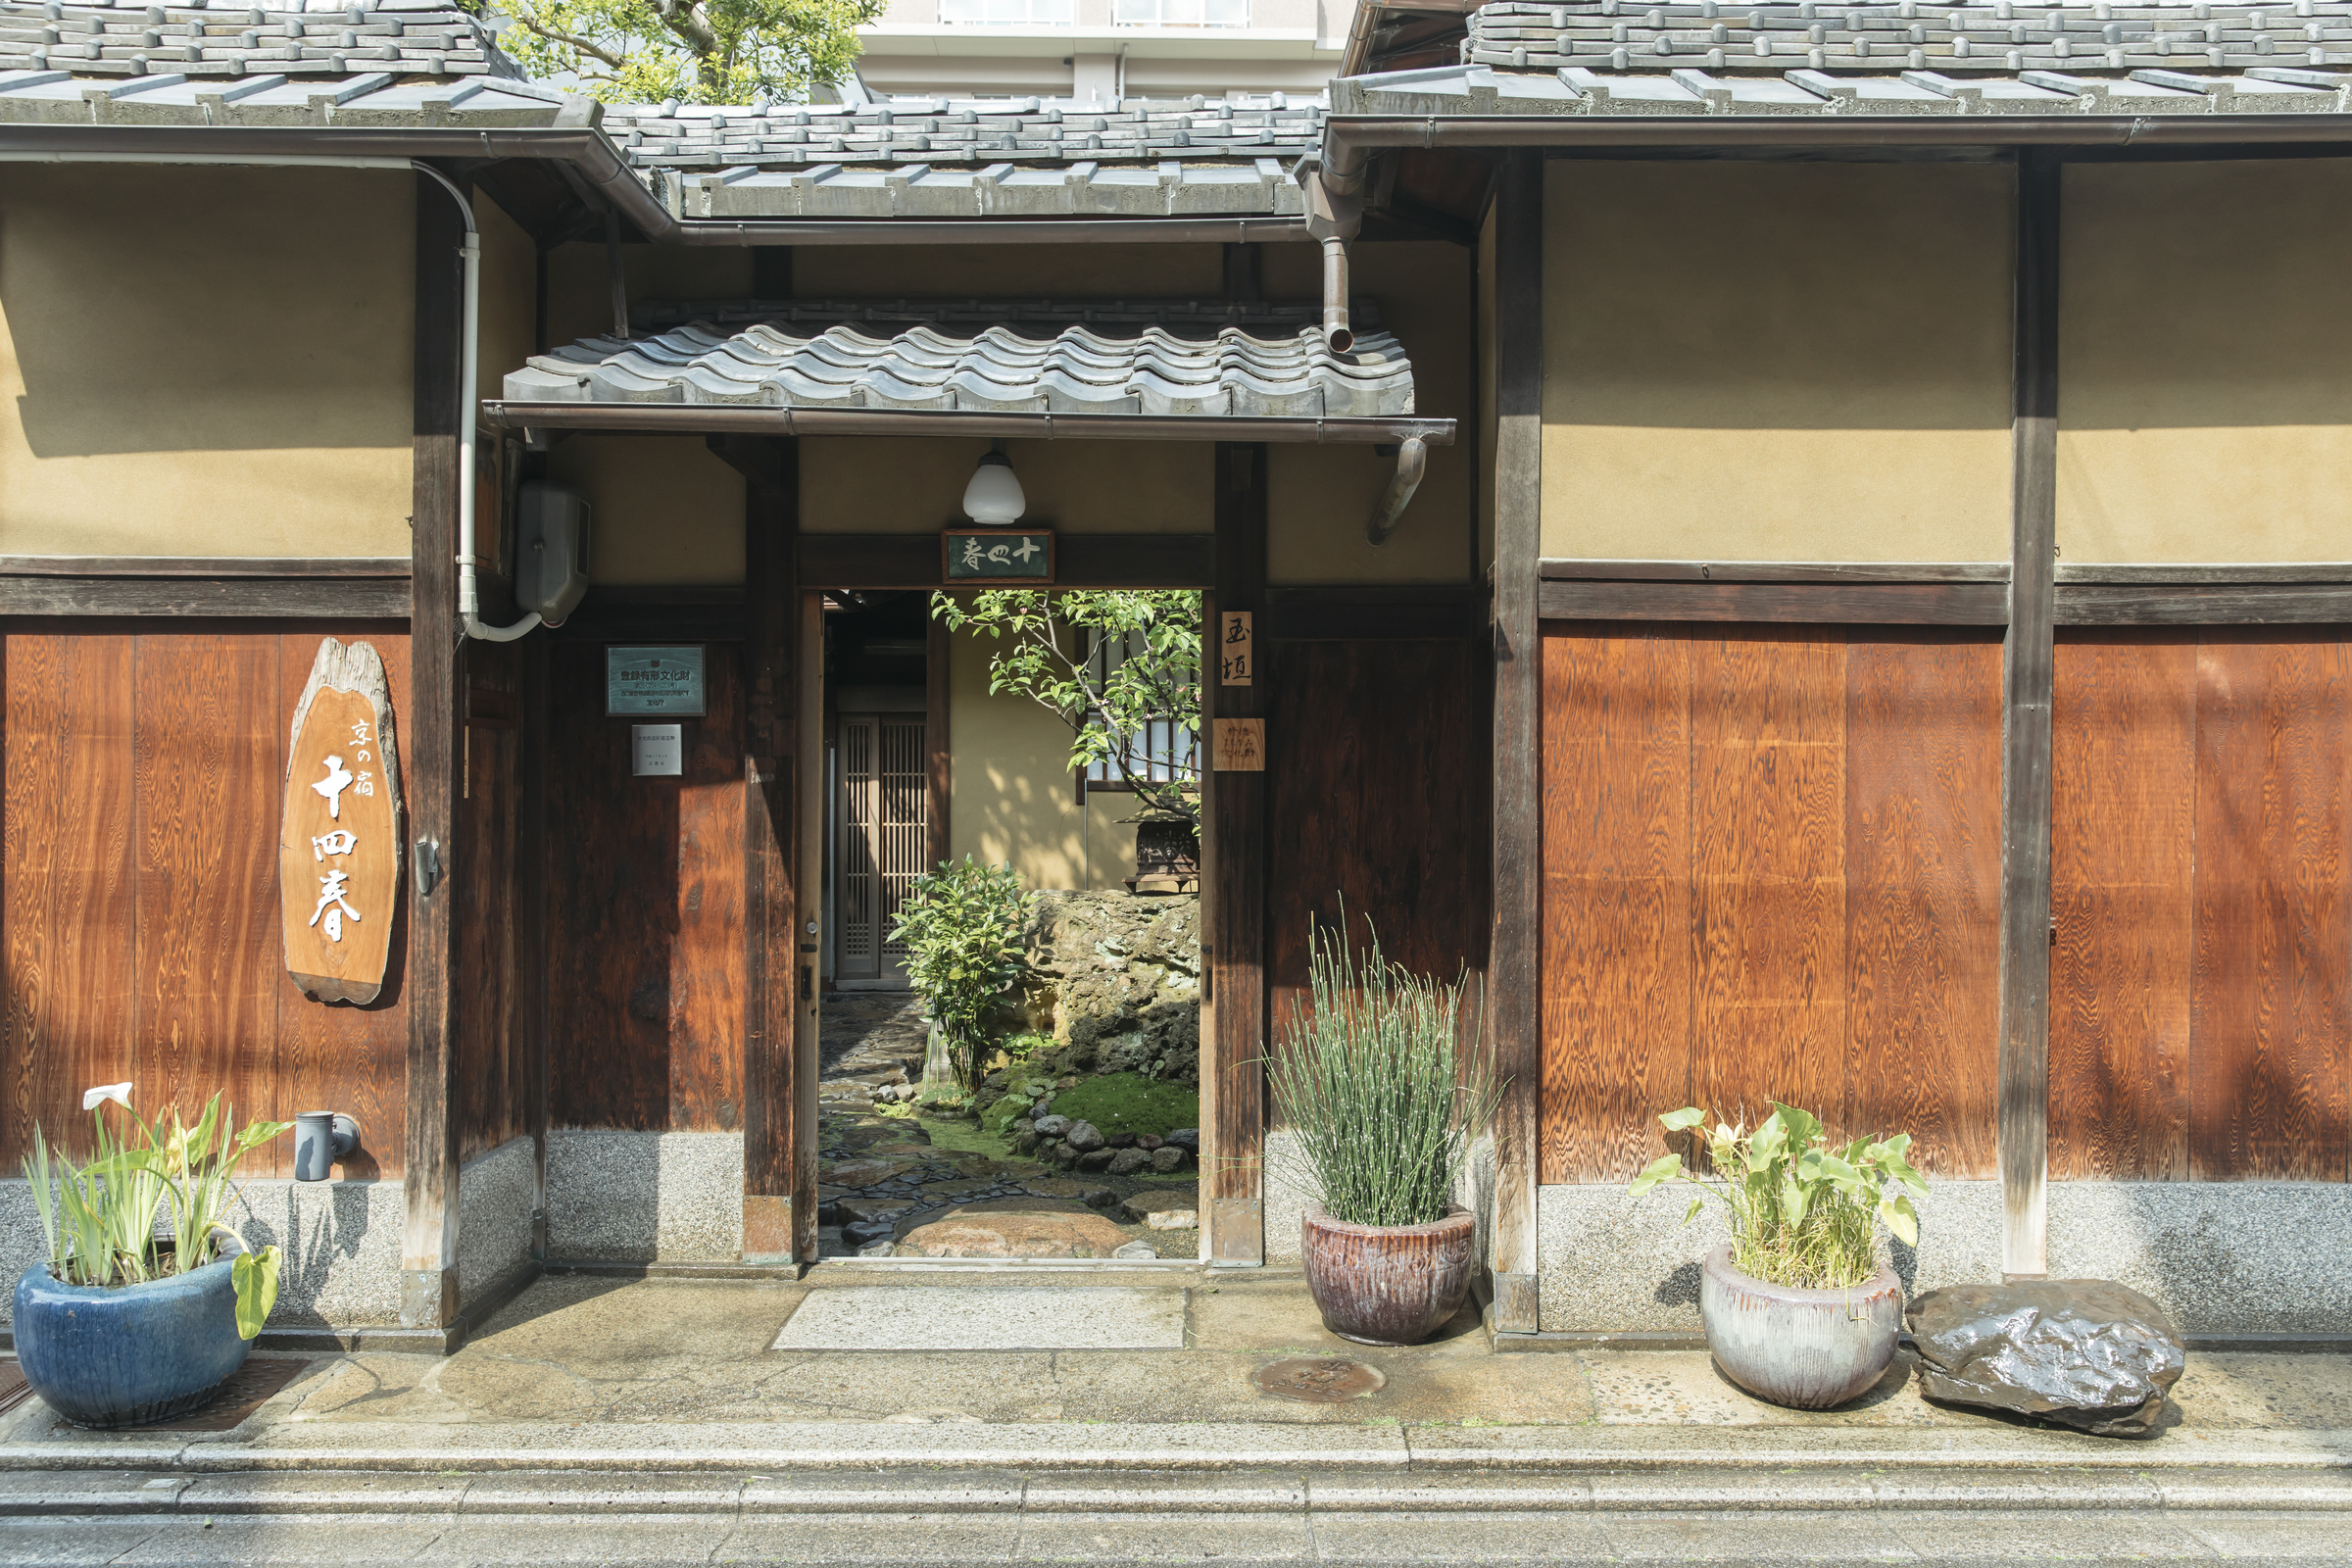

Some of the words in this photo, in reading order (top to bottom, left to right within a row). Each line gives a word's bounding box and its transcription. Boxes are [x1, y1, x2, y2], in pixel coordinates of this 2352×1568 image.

[961, 536, 1041, 570] 十四春
[620, 670, 690, 681] 登録有形文化財
[1222, 616, 1251, 680] 玉垣
[349, 718, 374, 797] 京の宿
[309, 755, 362, 942] 十四春
